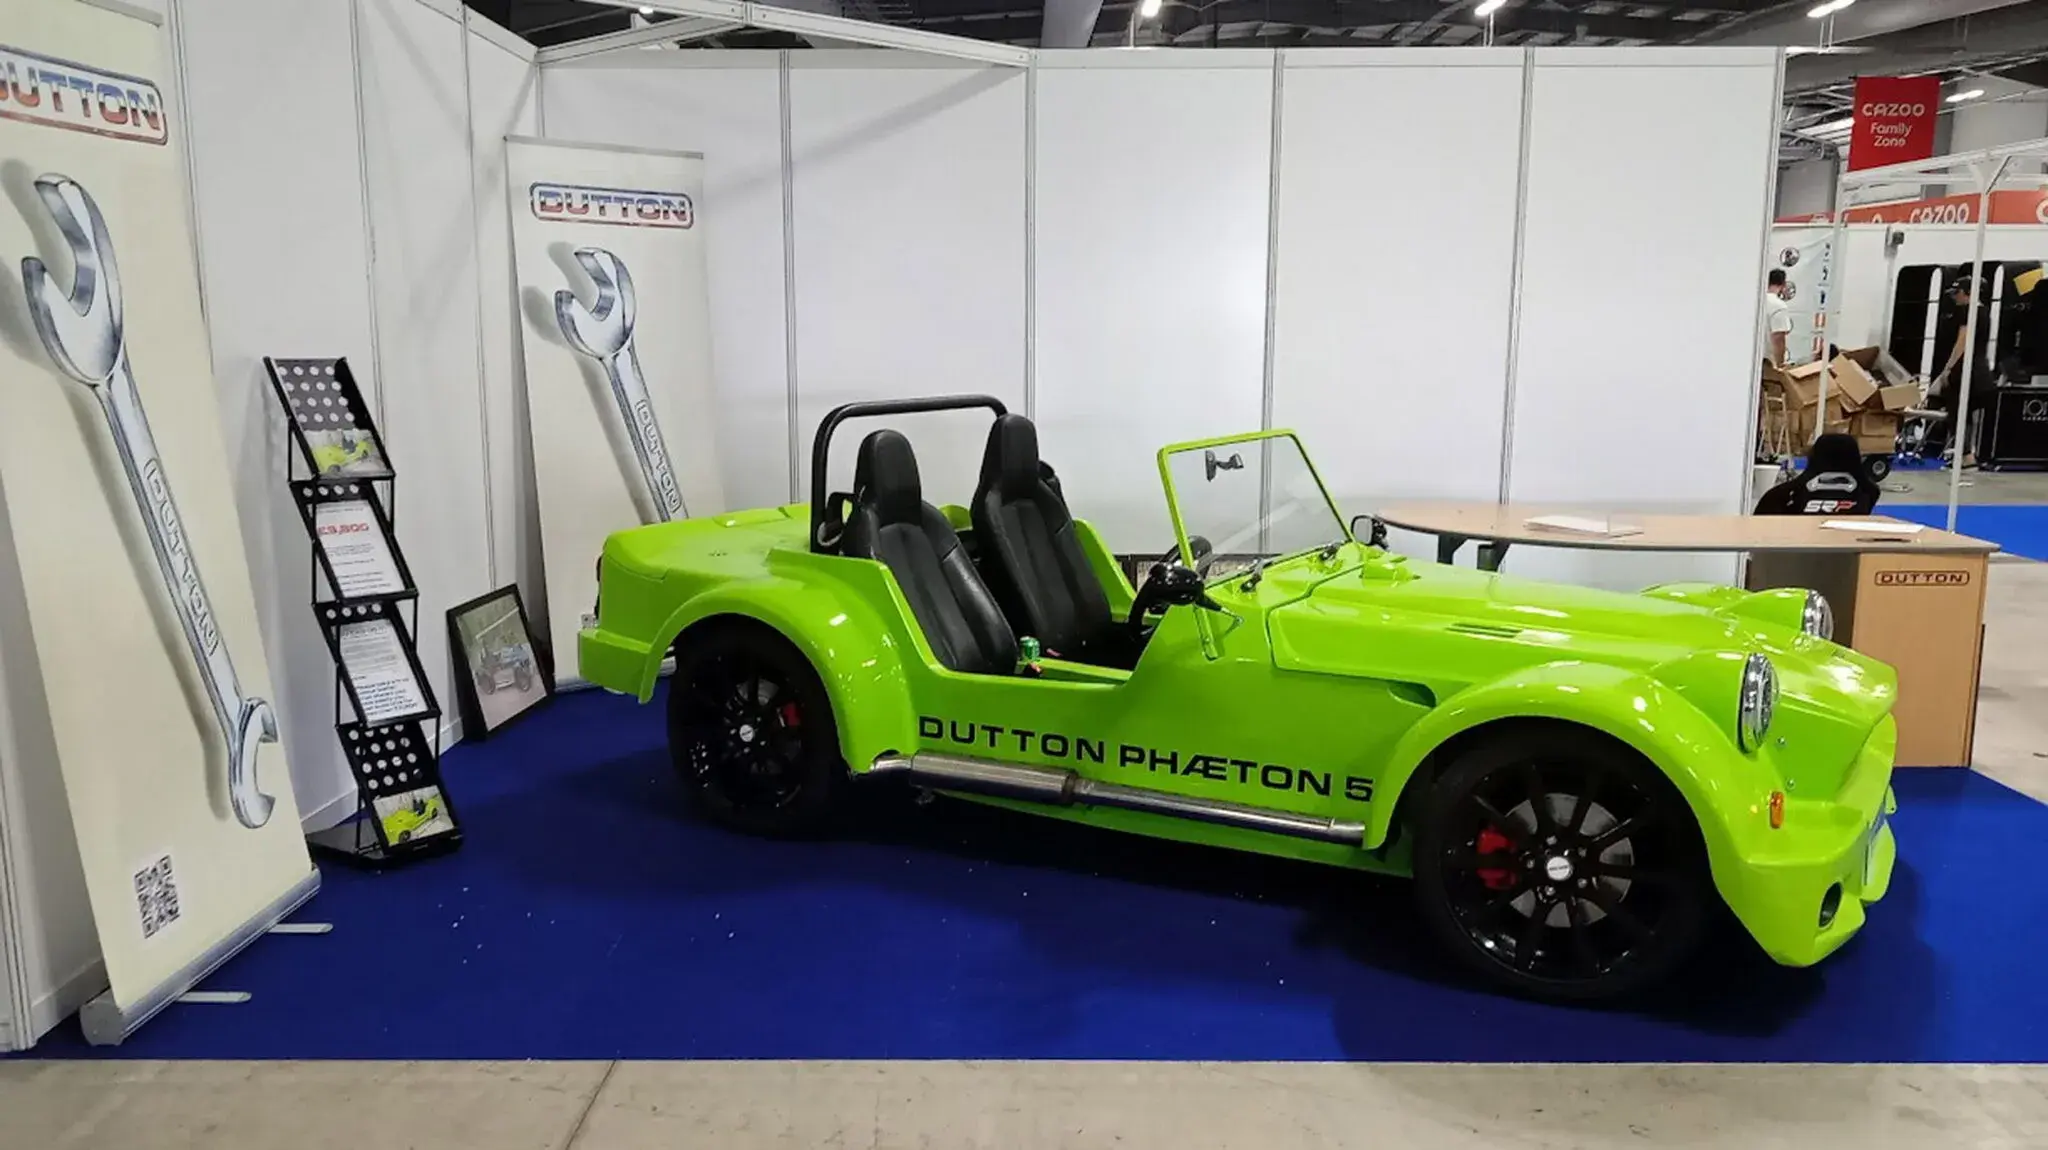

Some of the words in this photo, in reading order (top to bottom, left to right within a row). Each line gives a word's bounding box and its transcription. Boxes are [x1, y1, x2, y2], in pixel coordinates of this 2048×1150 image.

[1861, 103, 1926, 117] CAZOO
[1870, 121, 1913, 137] Family
[1873, 135, 1906, 147] Zone
[538, 190, 687, 221] DUTTON
[1908, 202, 1970, 224] CAZOO
[637, 402, 682, 511] DUTTON
[146, 465, 217, 650] DUTTON
[1881, 573, 1963, 584] DUTTON
[918, 715, 1105, 764] DUTTON
[1119, 744, 1333, 798] PHÆTON
[1345, 777, 1375, 804] 5
